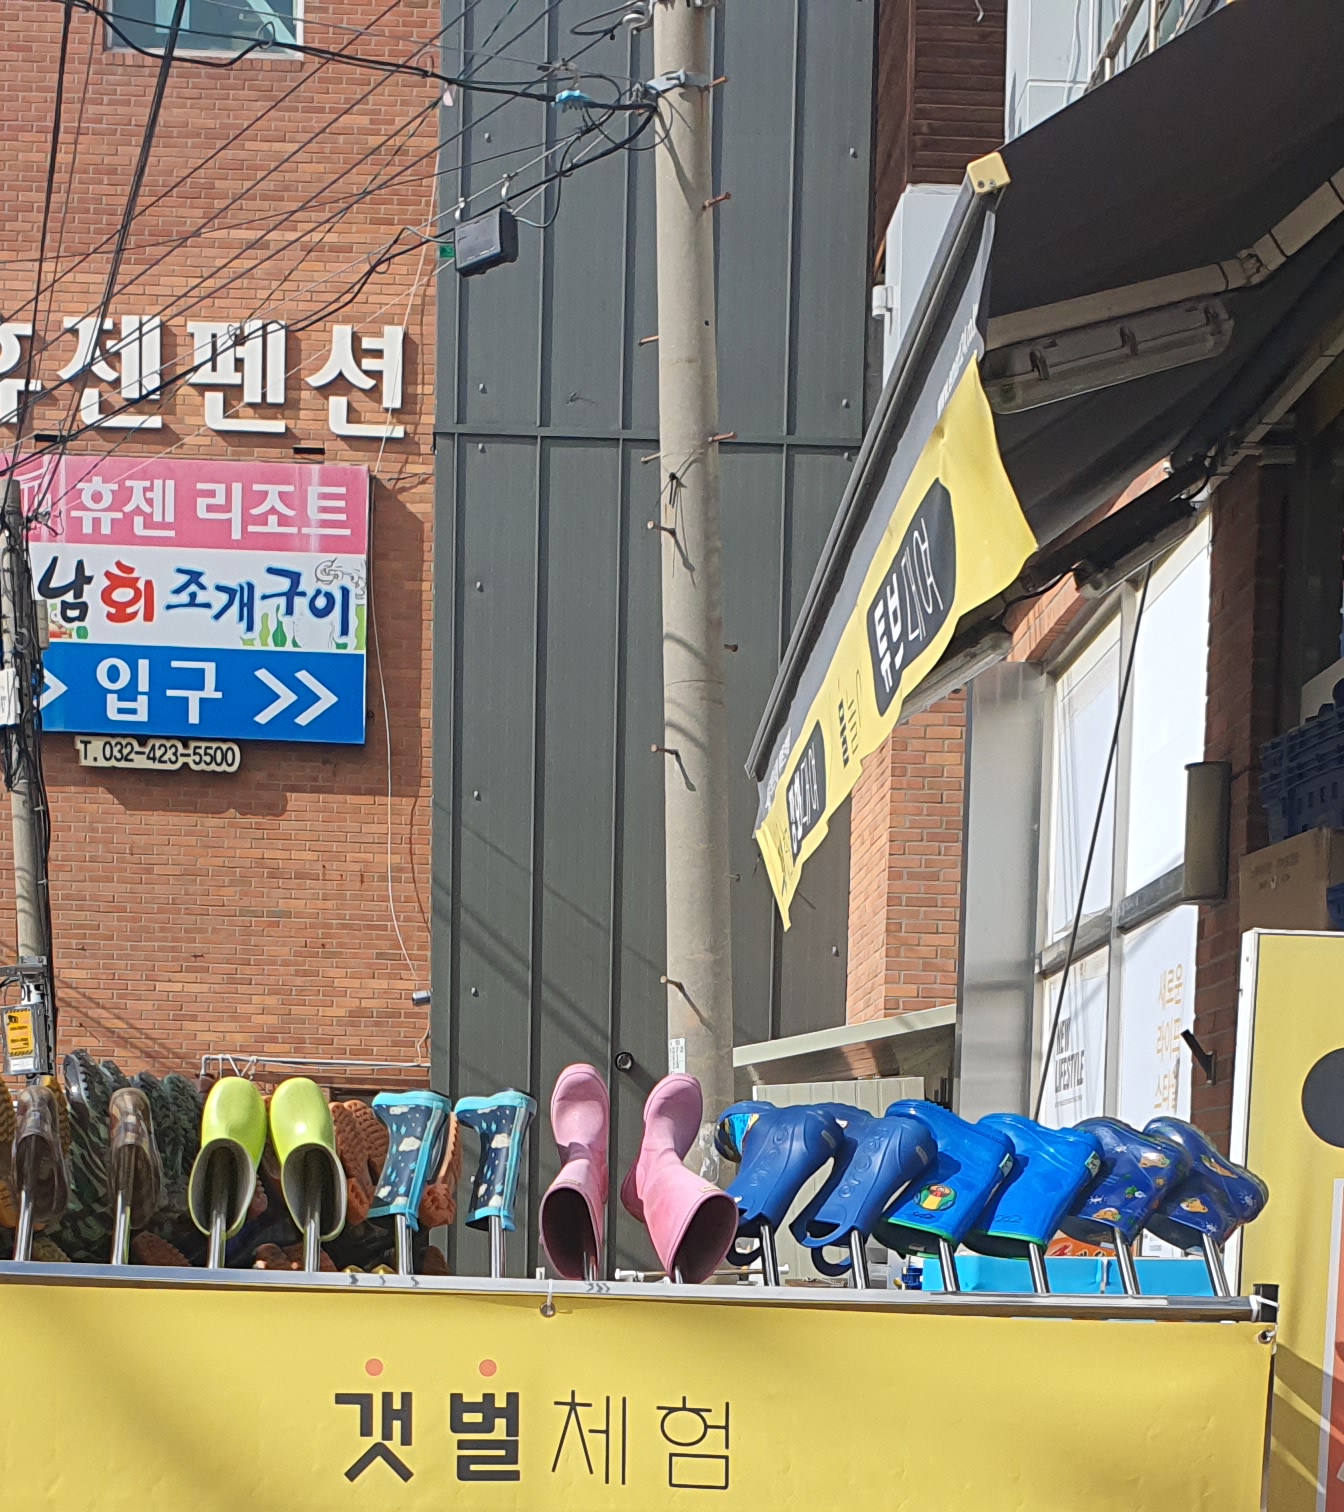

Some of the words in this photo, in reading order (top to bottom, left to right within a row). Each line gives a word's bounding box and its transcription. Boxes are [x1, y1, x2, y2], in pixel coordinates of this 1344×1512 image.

[70, 477, 175, 536] 휴젠
[196, 482, 352, 540] 리조트
[96, 656, 223, 724] 입구
